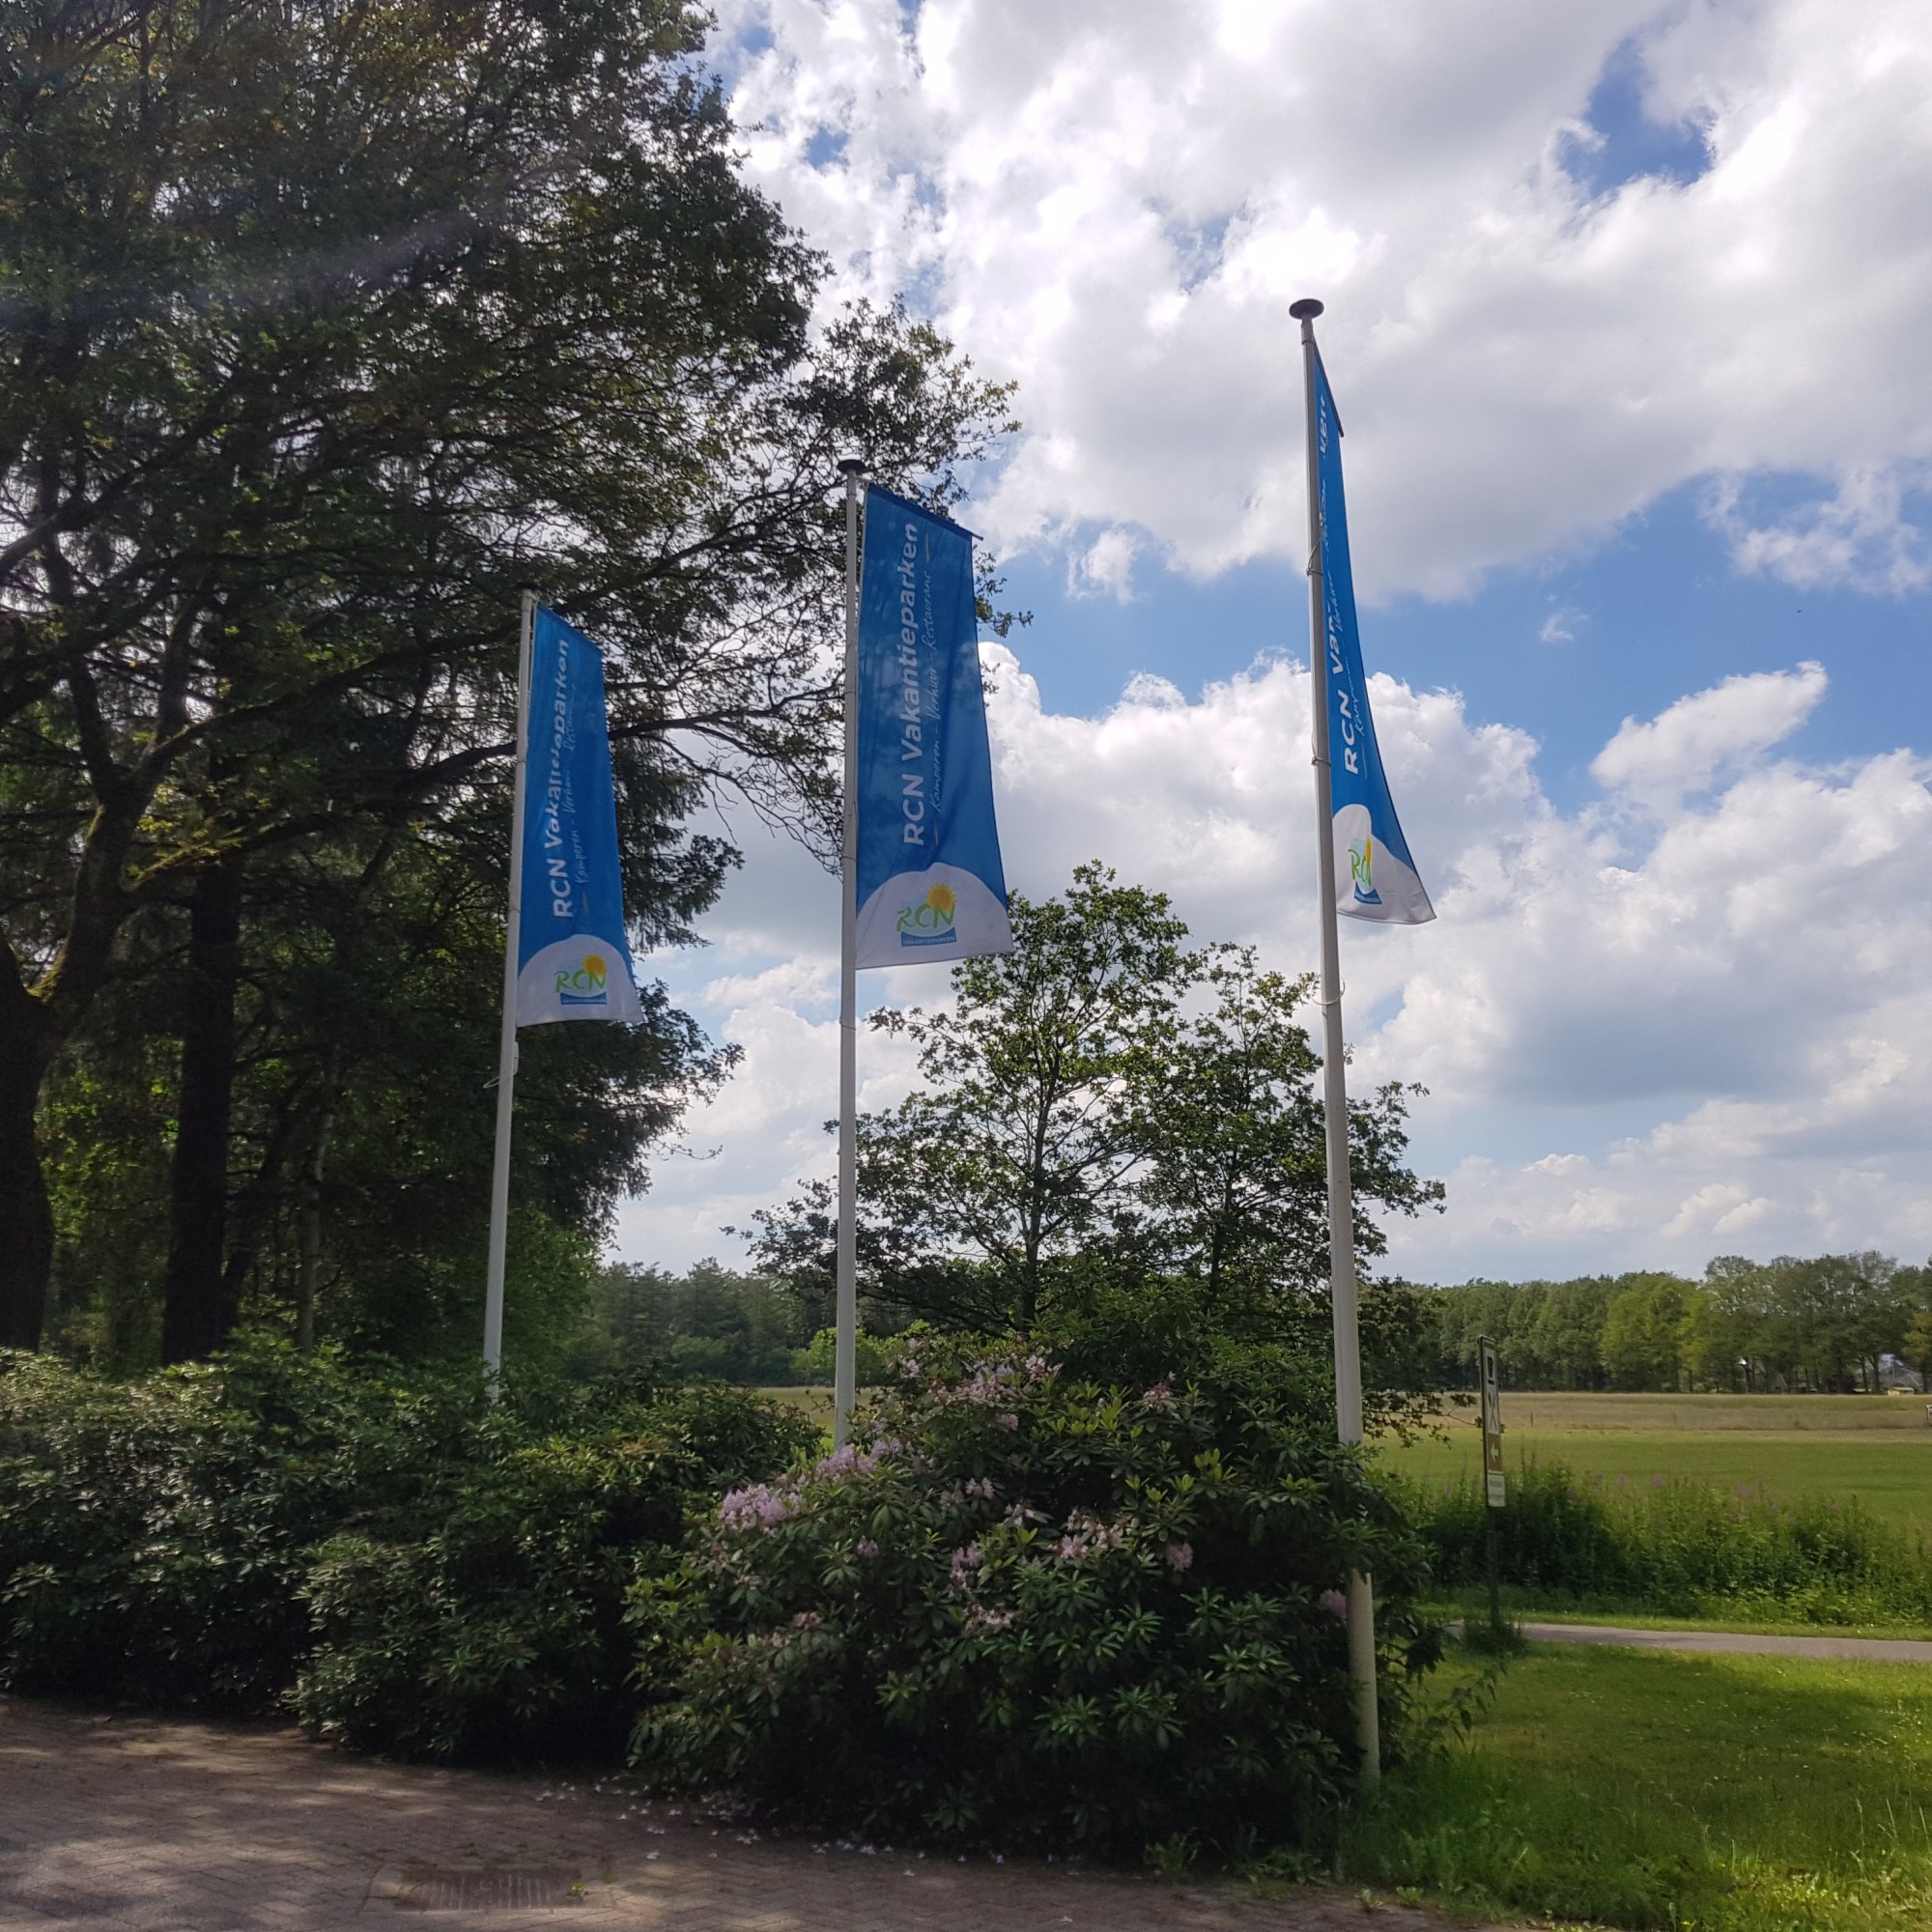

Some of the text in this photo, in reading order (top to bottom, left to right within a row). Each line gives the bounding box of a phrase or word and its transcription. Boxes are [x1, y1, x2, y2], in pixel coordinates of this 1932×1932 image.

[921, 571, 937, 651] Restaurant
[896, 523, 924, 845] RCN Vakantieparken
[924, 668, 941, 720] Verhuur
[1337, 689, 1359, 775] RCN
[544, 639, 575, 918] RCN Vakanieparken
[929, 740, 943, 812] Kamperen
[896, 902, 955, 932] RCN
[554, 967, 607, 993] RCN
